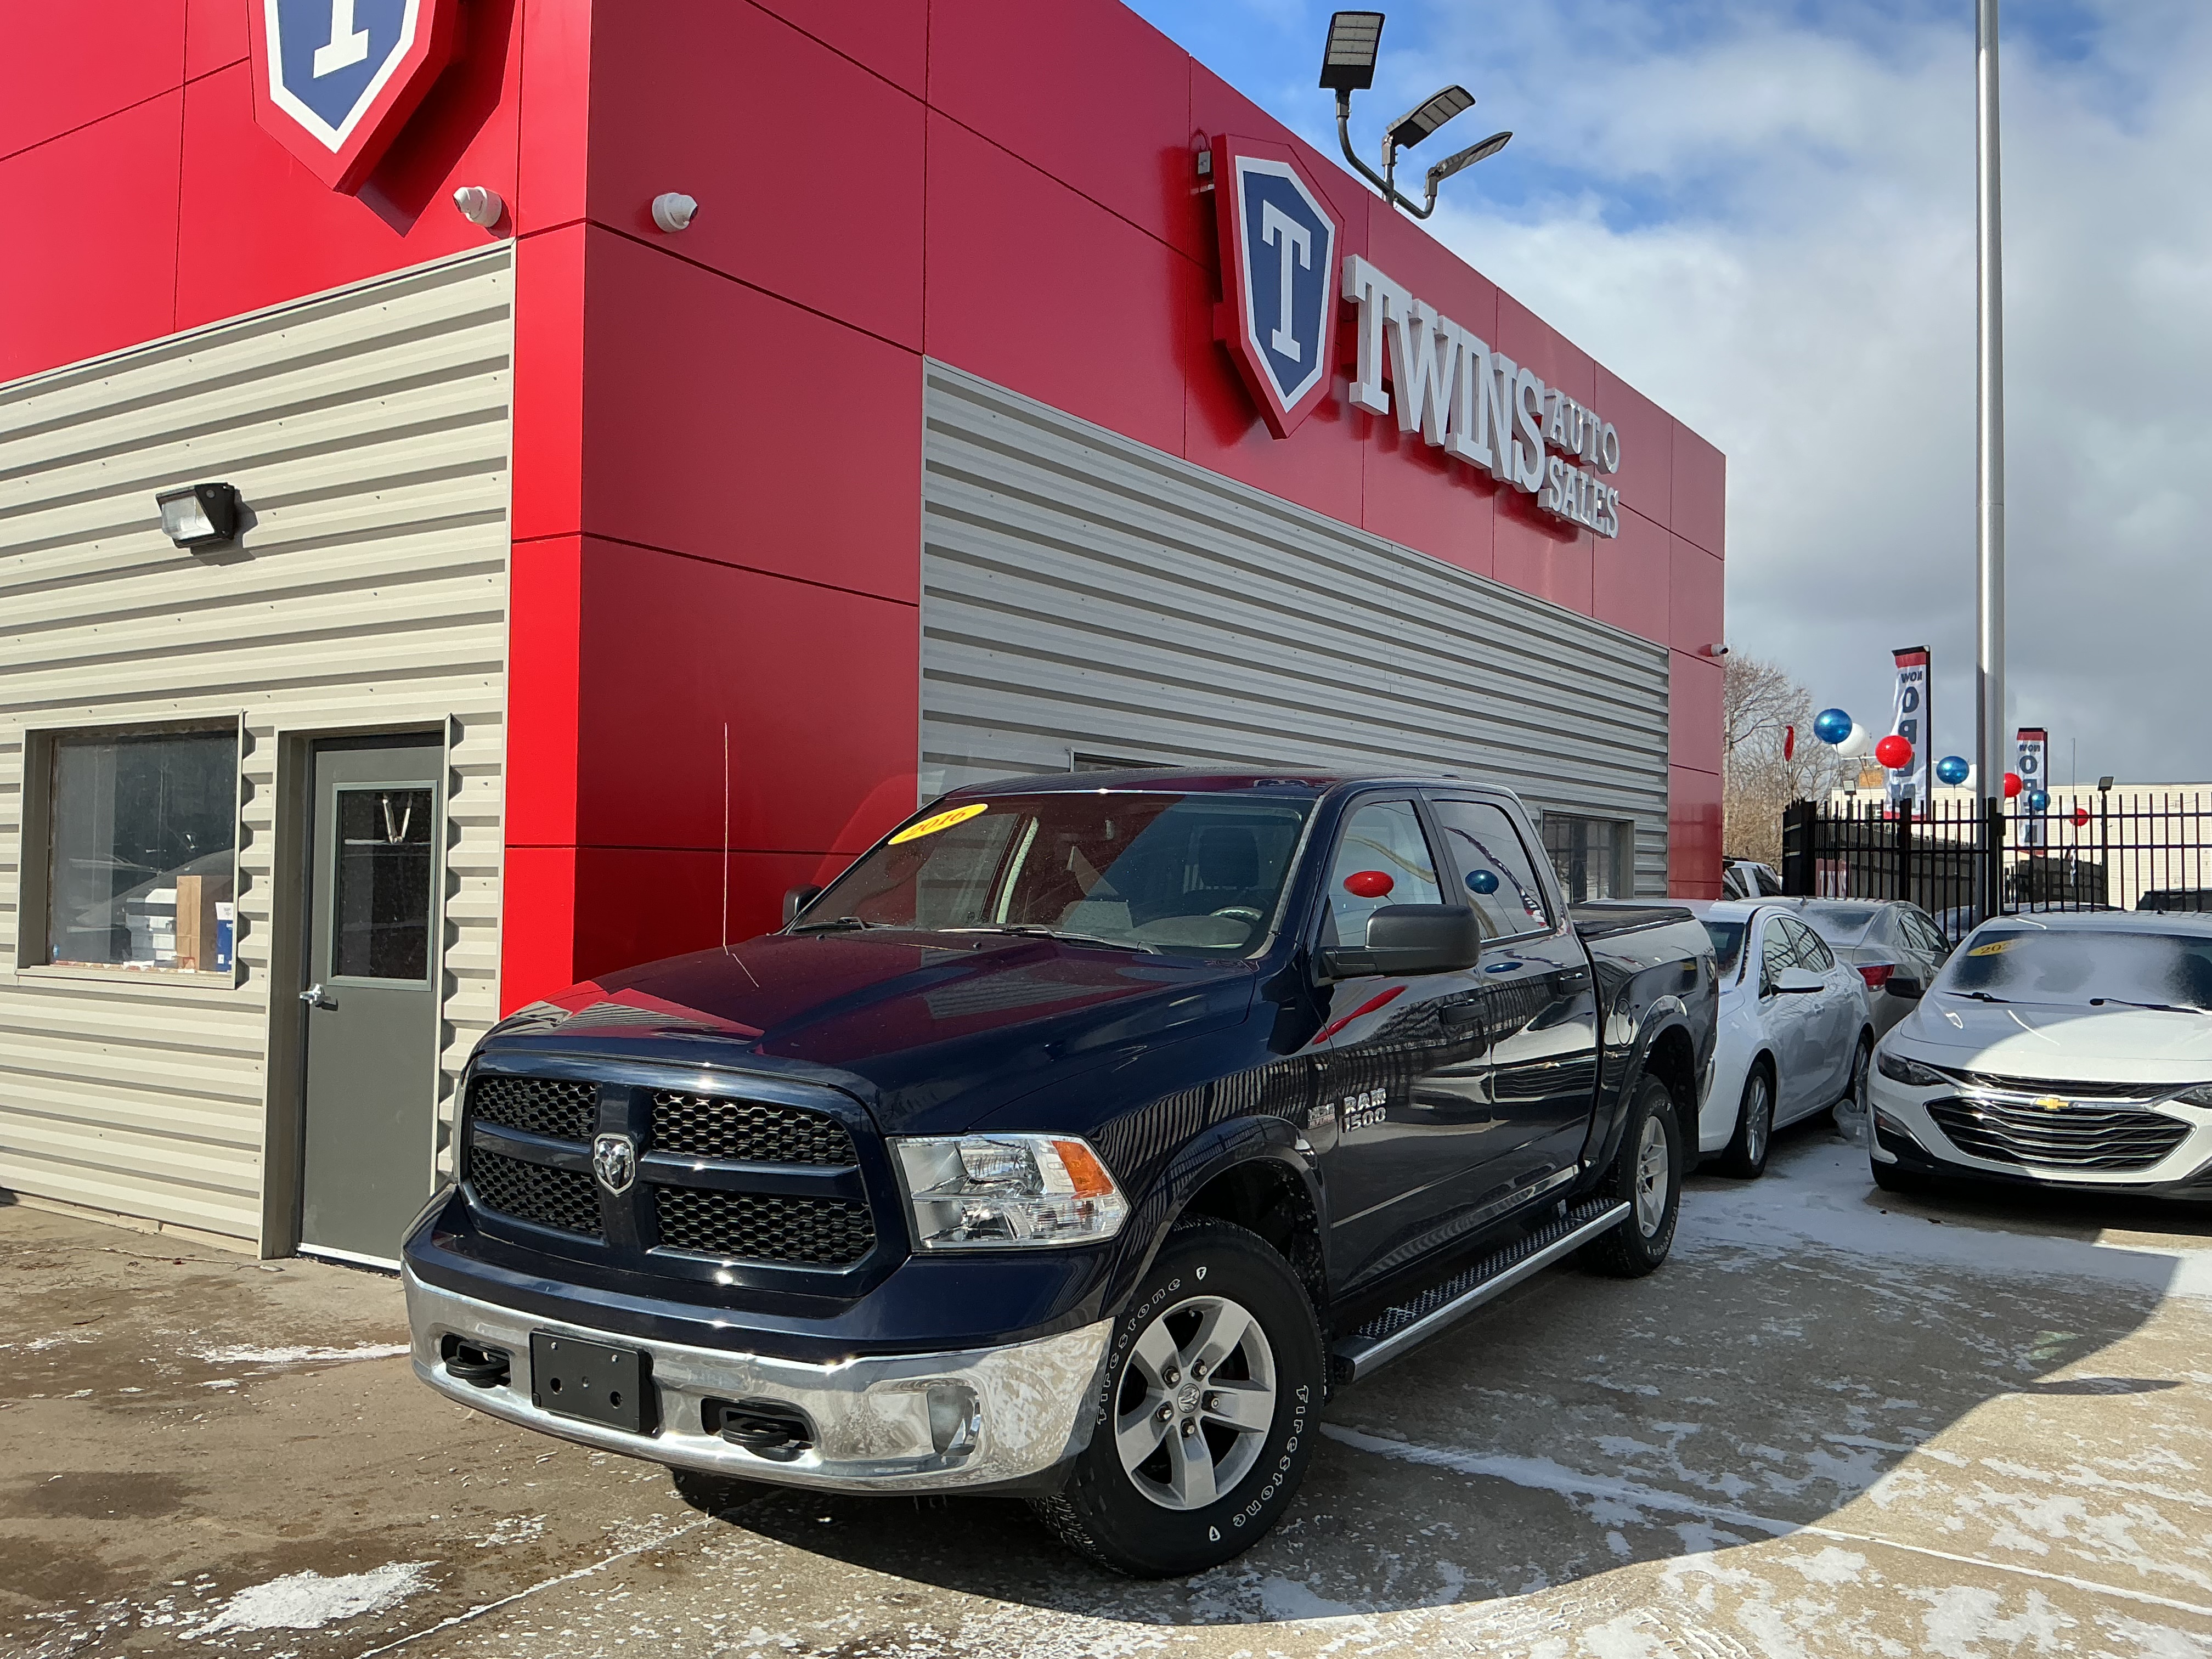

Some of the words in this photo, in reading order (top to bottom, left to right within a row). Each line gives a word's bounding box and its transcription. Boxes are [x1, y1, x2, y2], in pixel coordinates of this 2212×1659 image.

[1262, 200, 1311, 363] T
[1342, 254, 1545, 493] TWINS
[1542, 387, 1620, 475] AUTO
[1538, 455, 1619, 539] SALES
[902, 811, 966, 840] 2016
[1342, 1107, 1386, 1133] 1500
[1344, 1087, 1386, 1114] RAM
[1233, 1385, 1309, 1527] Firestone
